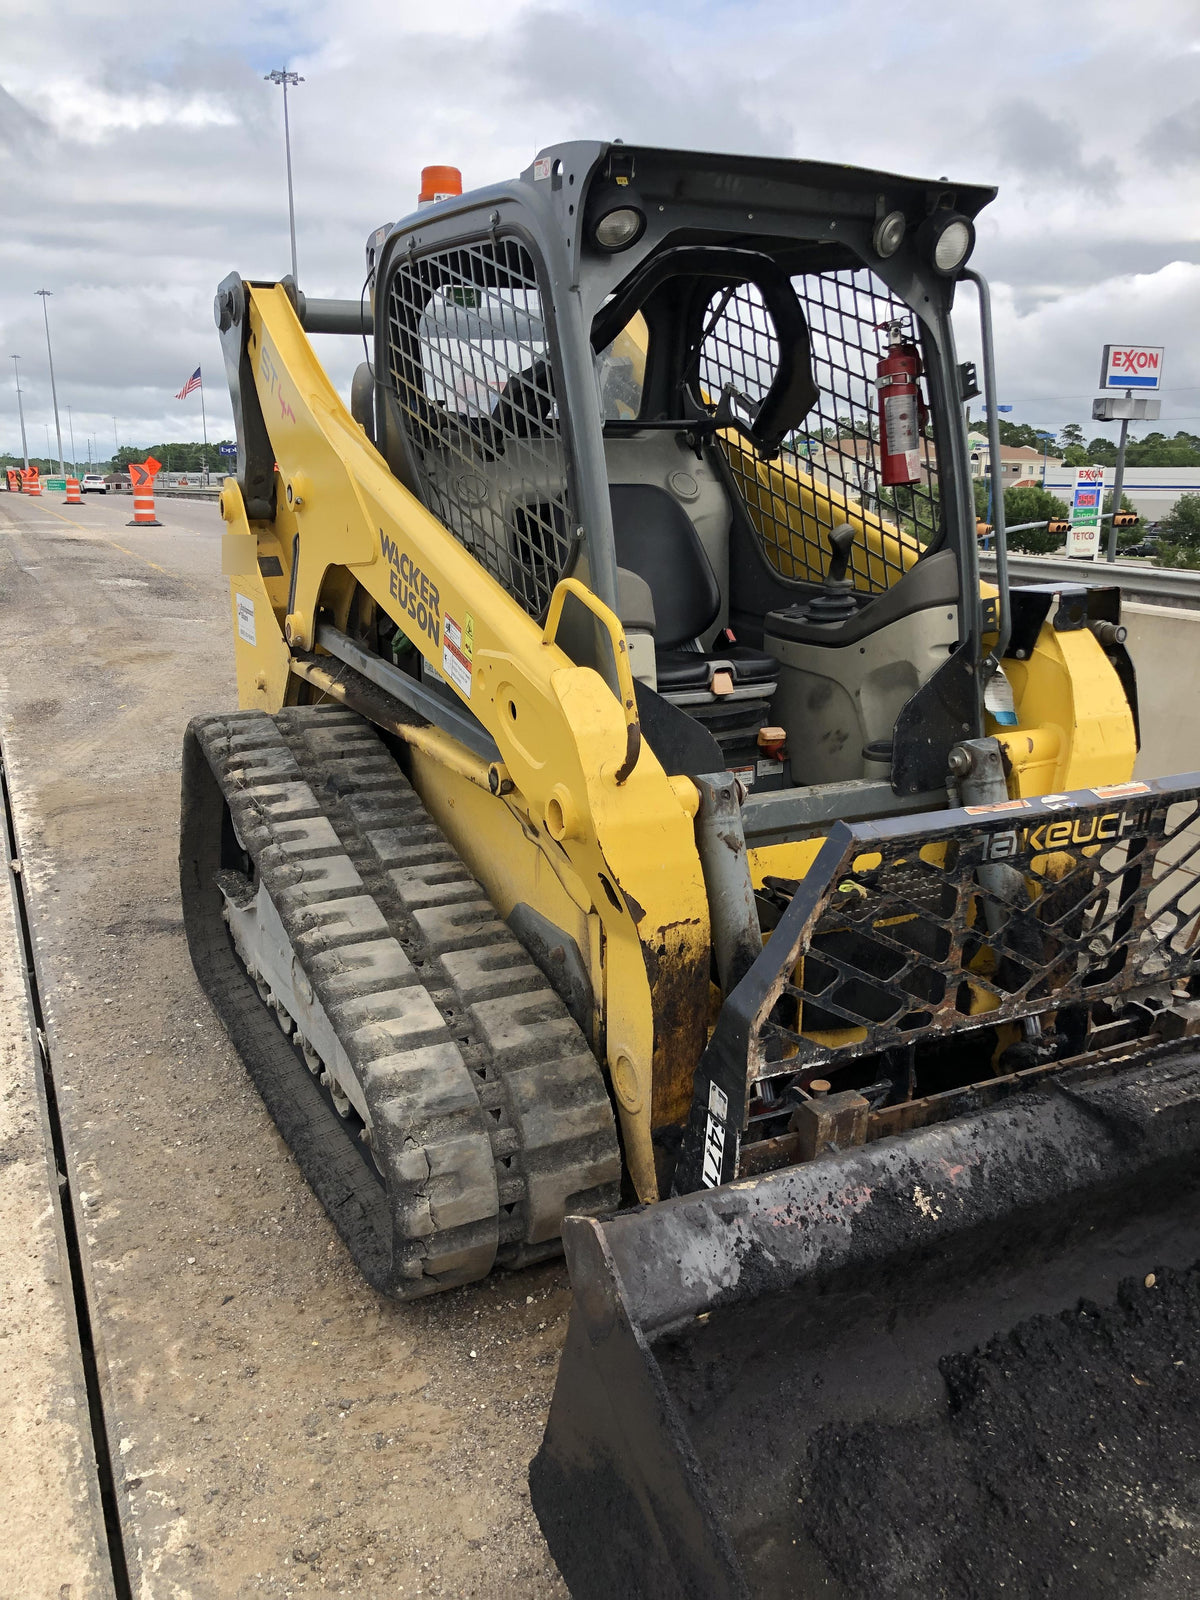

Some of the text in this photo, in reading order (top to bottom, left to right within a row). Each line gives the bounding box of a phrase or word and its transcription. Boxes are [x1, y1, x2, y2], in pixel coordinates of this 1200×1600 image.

[1112, 349, 1159, 374] EXXON
[1078, 469, 1103, 481] EXXON
[1073, 532, 1095, 540] TETCO
[379, 528, 440, 618] WACKER
[389, 569, 440, 648] EUSON
